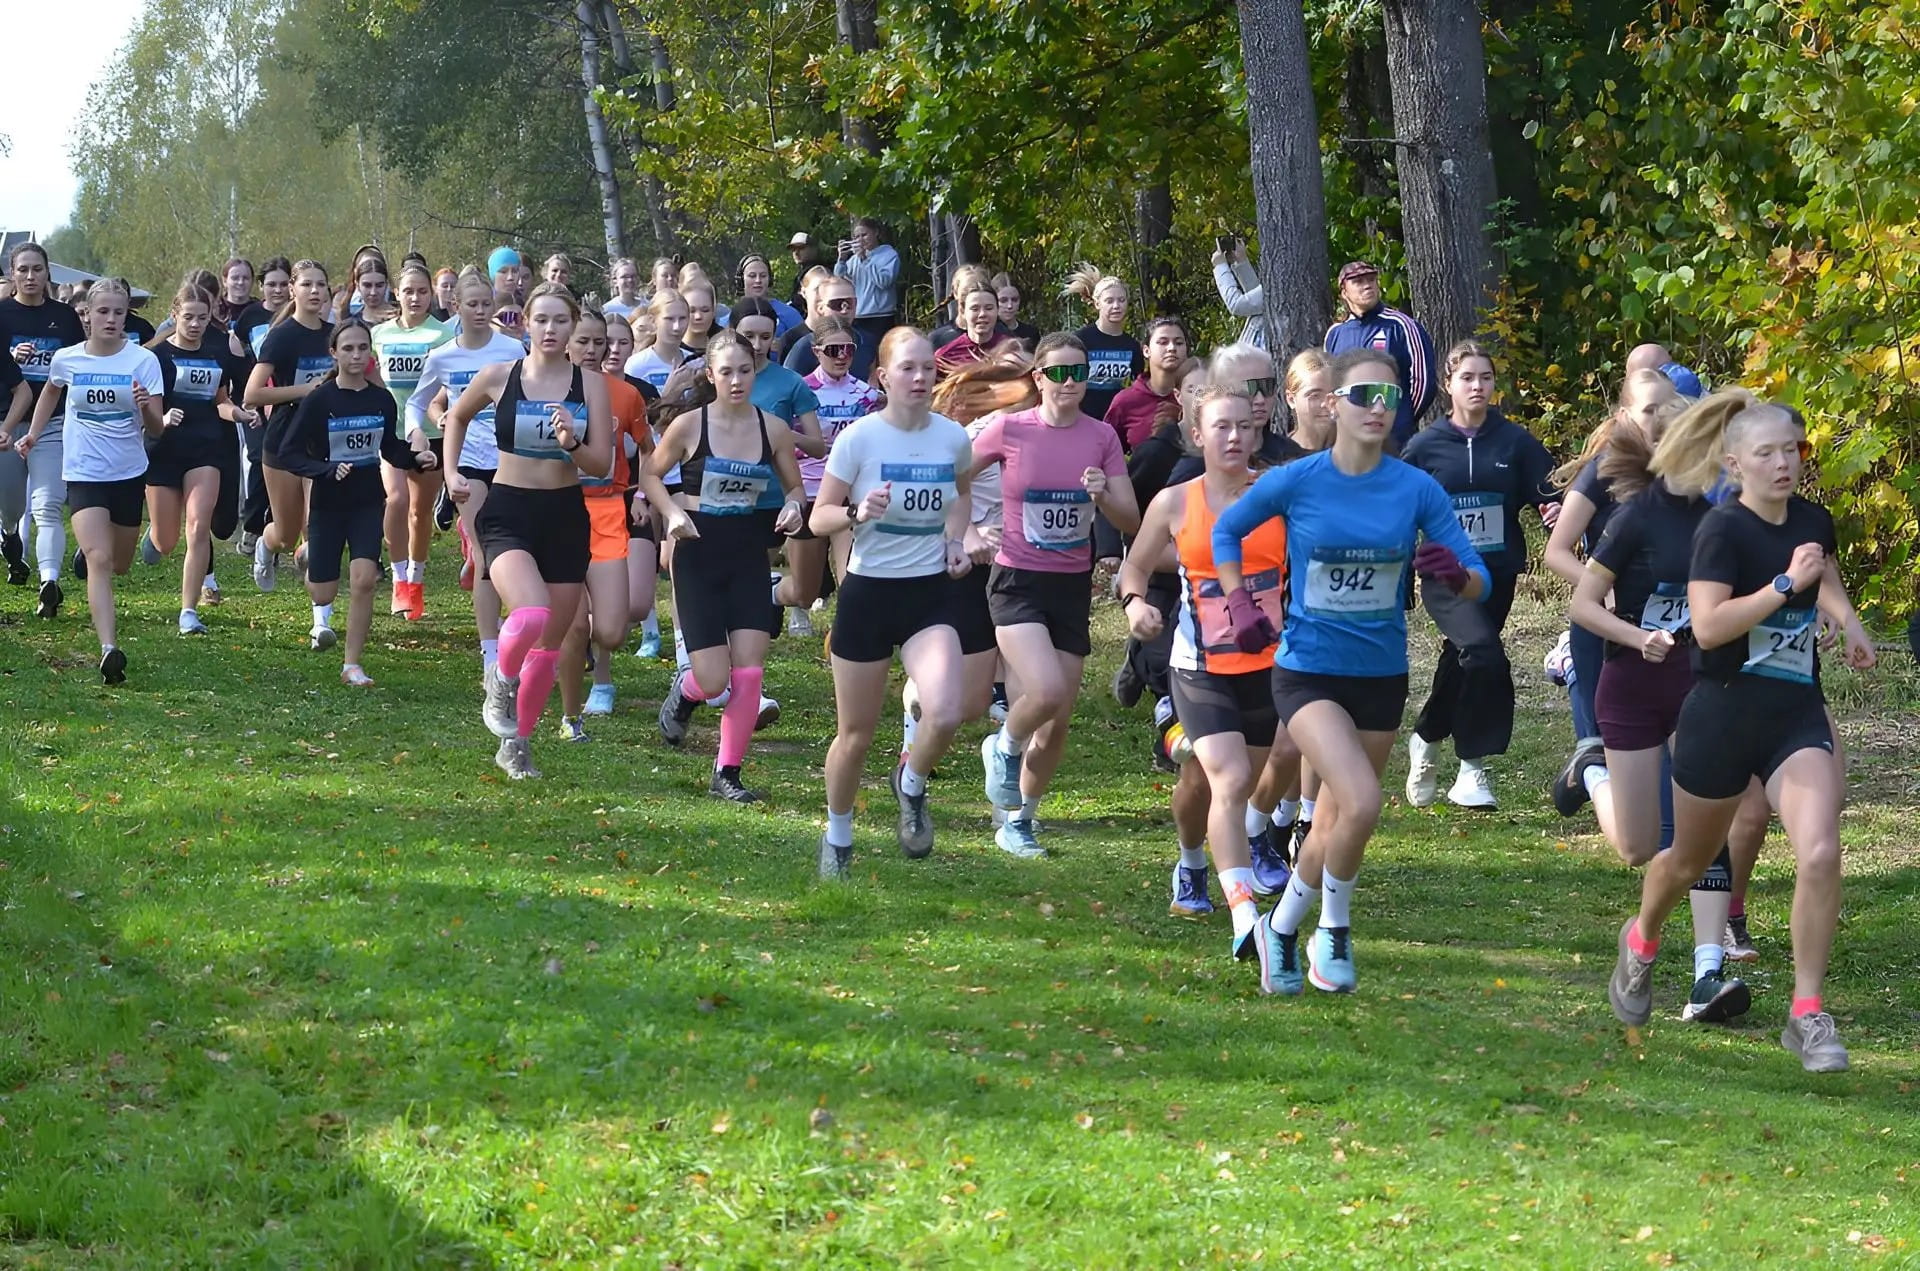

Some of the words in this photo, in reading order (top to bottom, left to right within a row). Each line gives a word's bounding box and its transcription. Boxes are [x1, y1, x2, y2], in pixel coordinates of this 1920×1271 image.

[86, 389, 115, 404] 609
[904, 489, 942, 511] 808
[1043, 508, 1079, 529] 905
[1329, 567, 1376, 592] 942
[1660, 599, 1689, 622] 21
